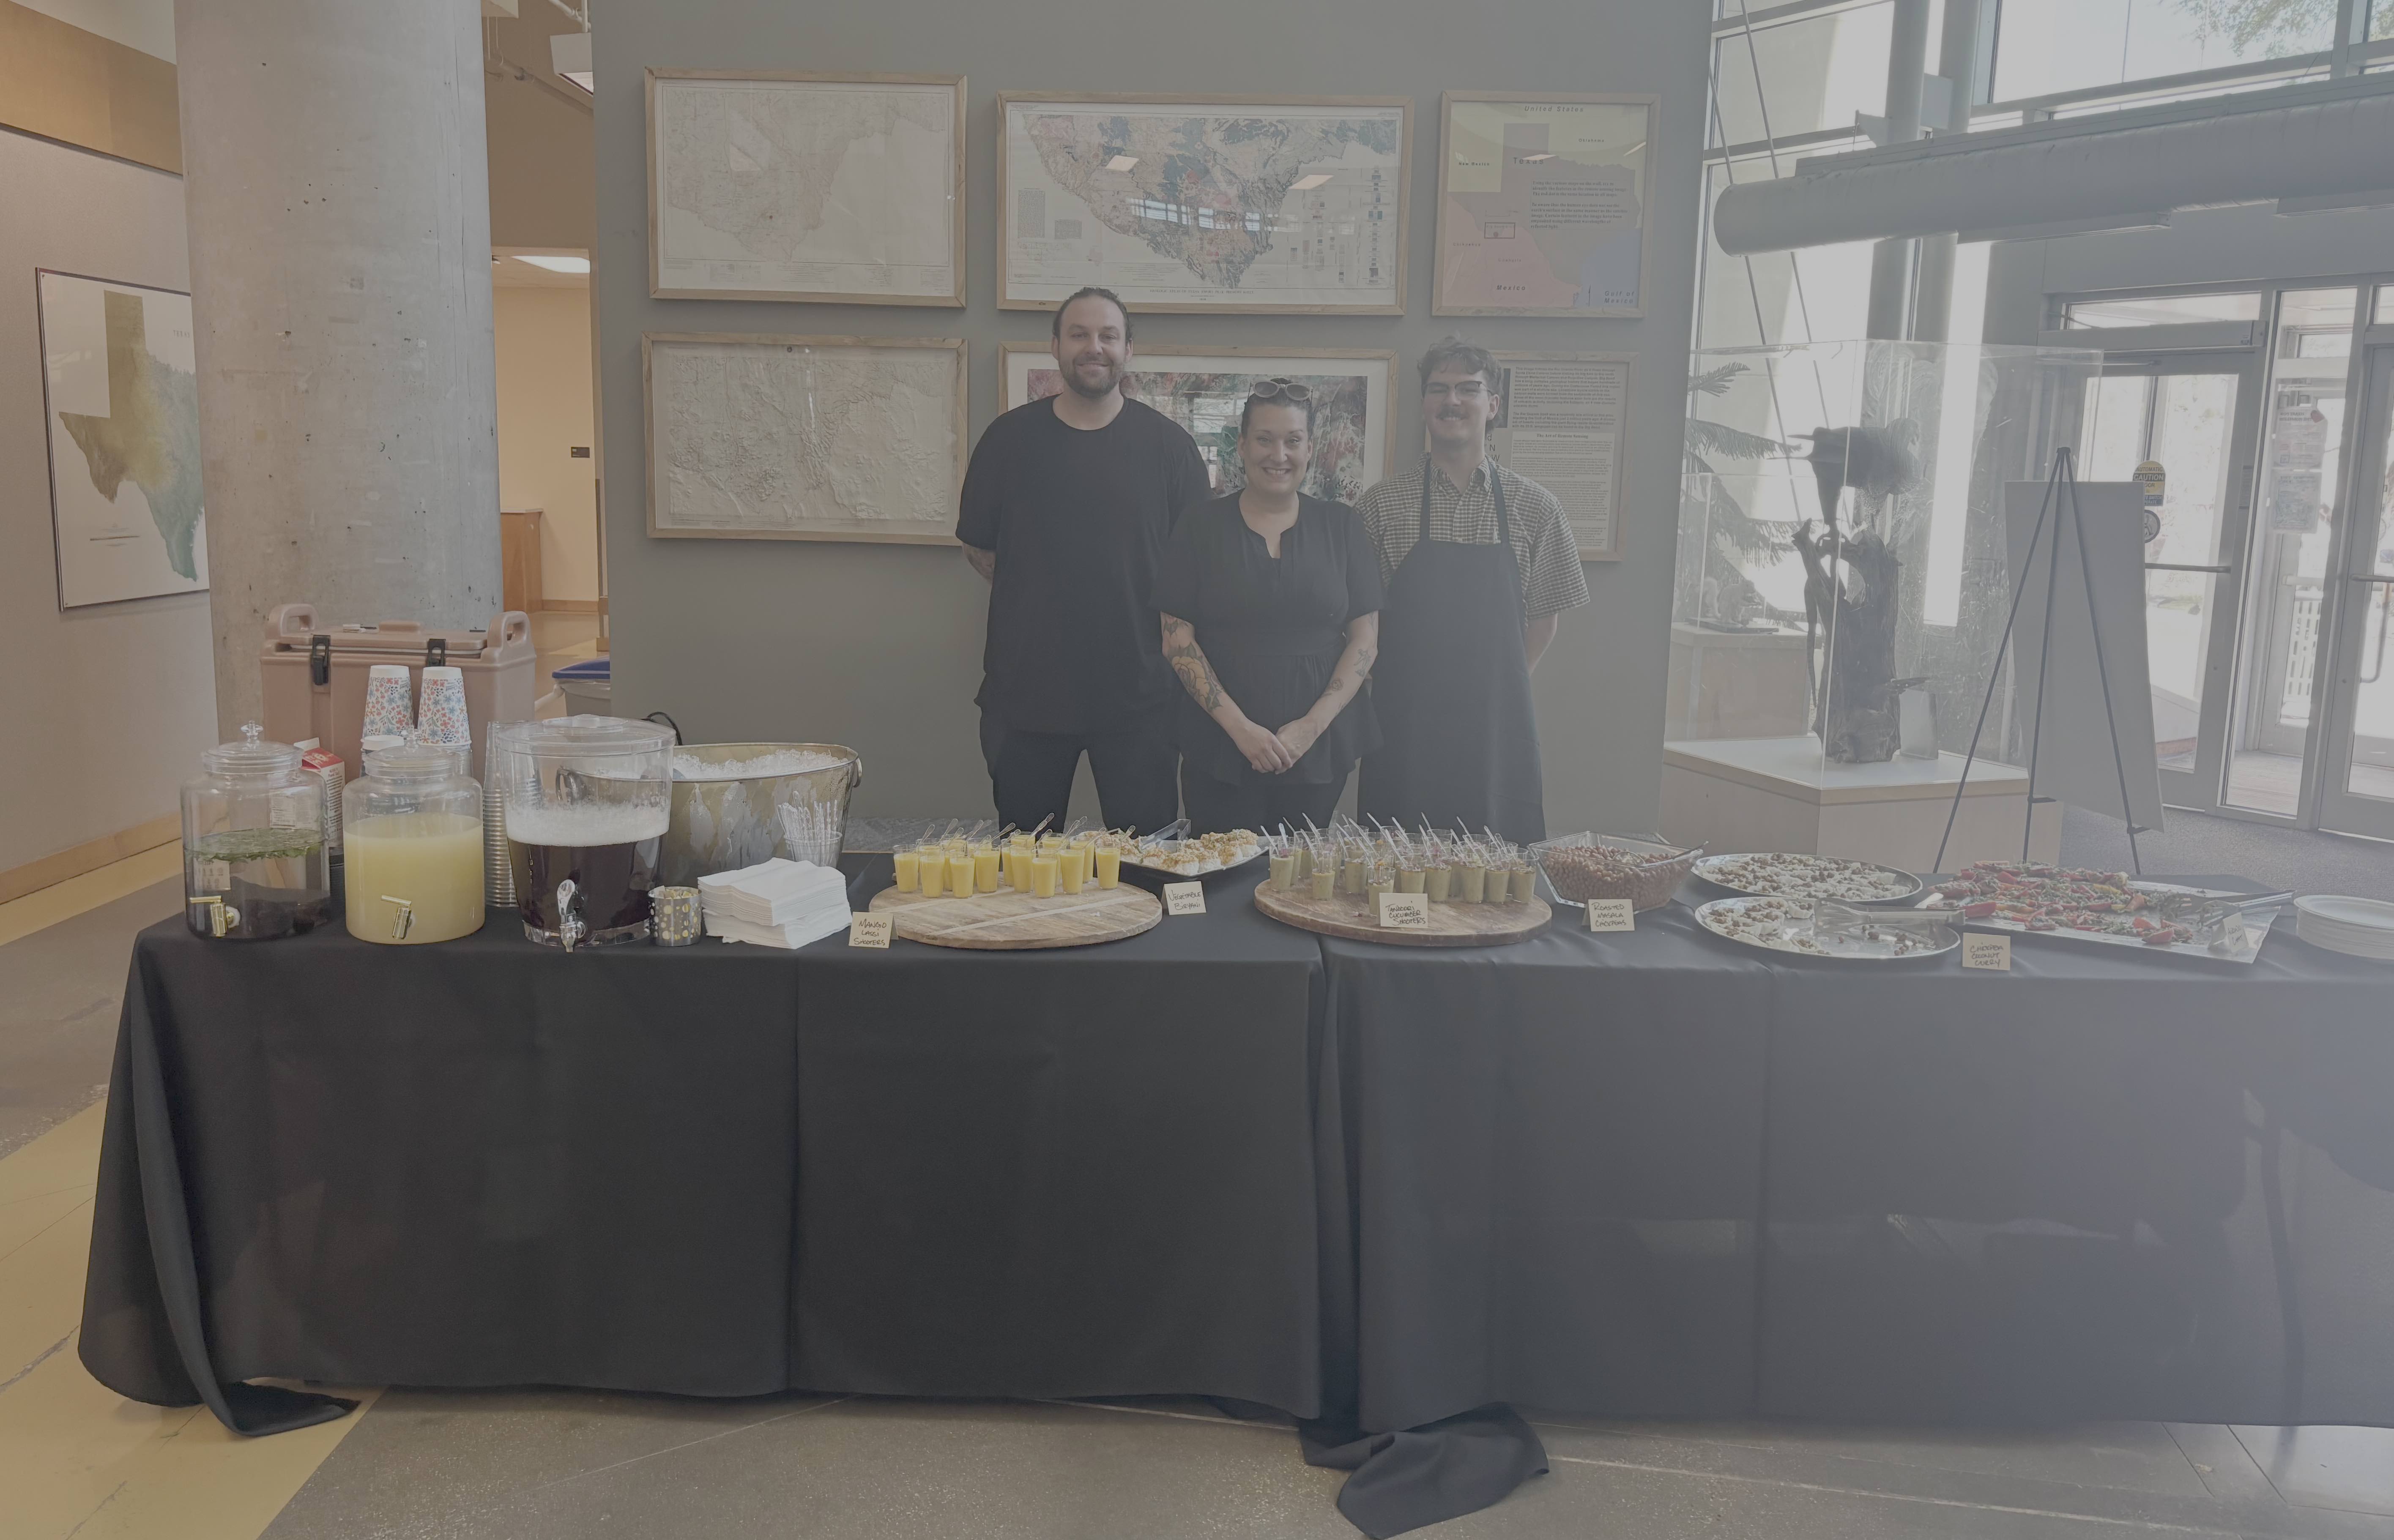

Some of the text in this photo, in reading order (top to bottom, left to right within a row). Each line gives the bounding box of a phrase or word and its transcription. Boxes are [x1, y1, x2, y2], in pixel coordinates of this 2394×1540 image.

[1591, 902, 1624, 910] ROASTED
[859, 918, 887, 928] MANGO
[1392, 917, 1425, 926] SHOOTERS
[854, 937, 885, 946] SHOOTERS
[1975, 959, 2000, 968] CURRY
